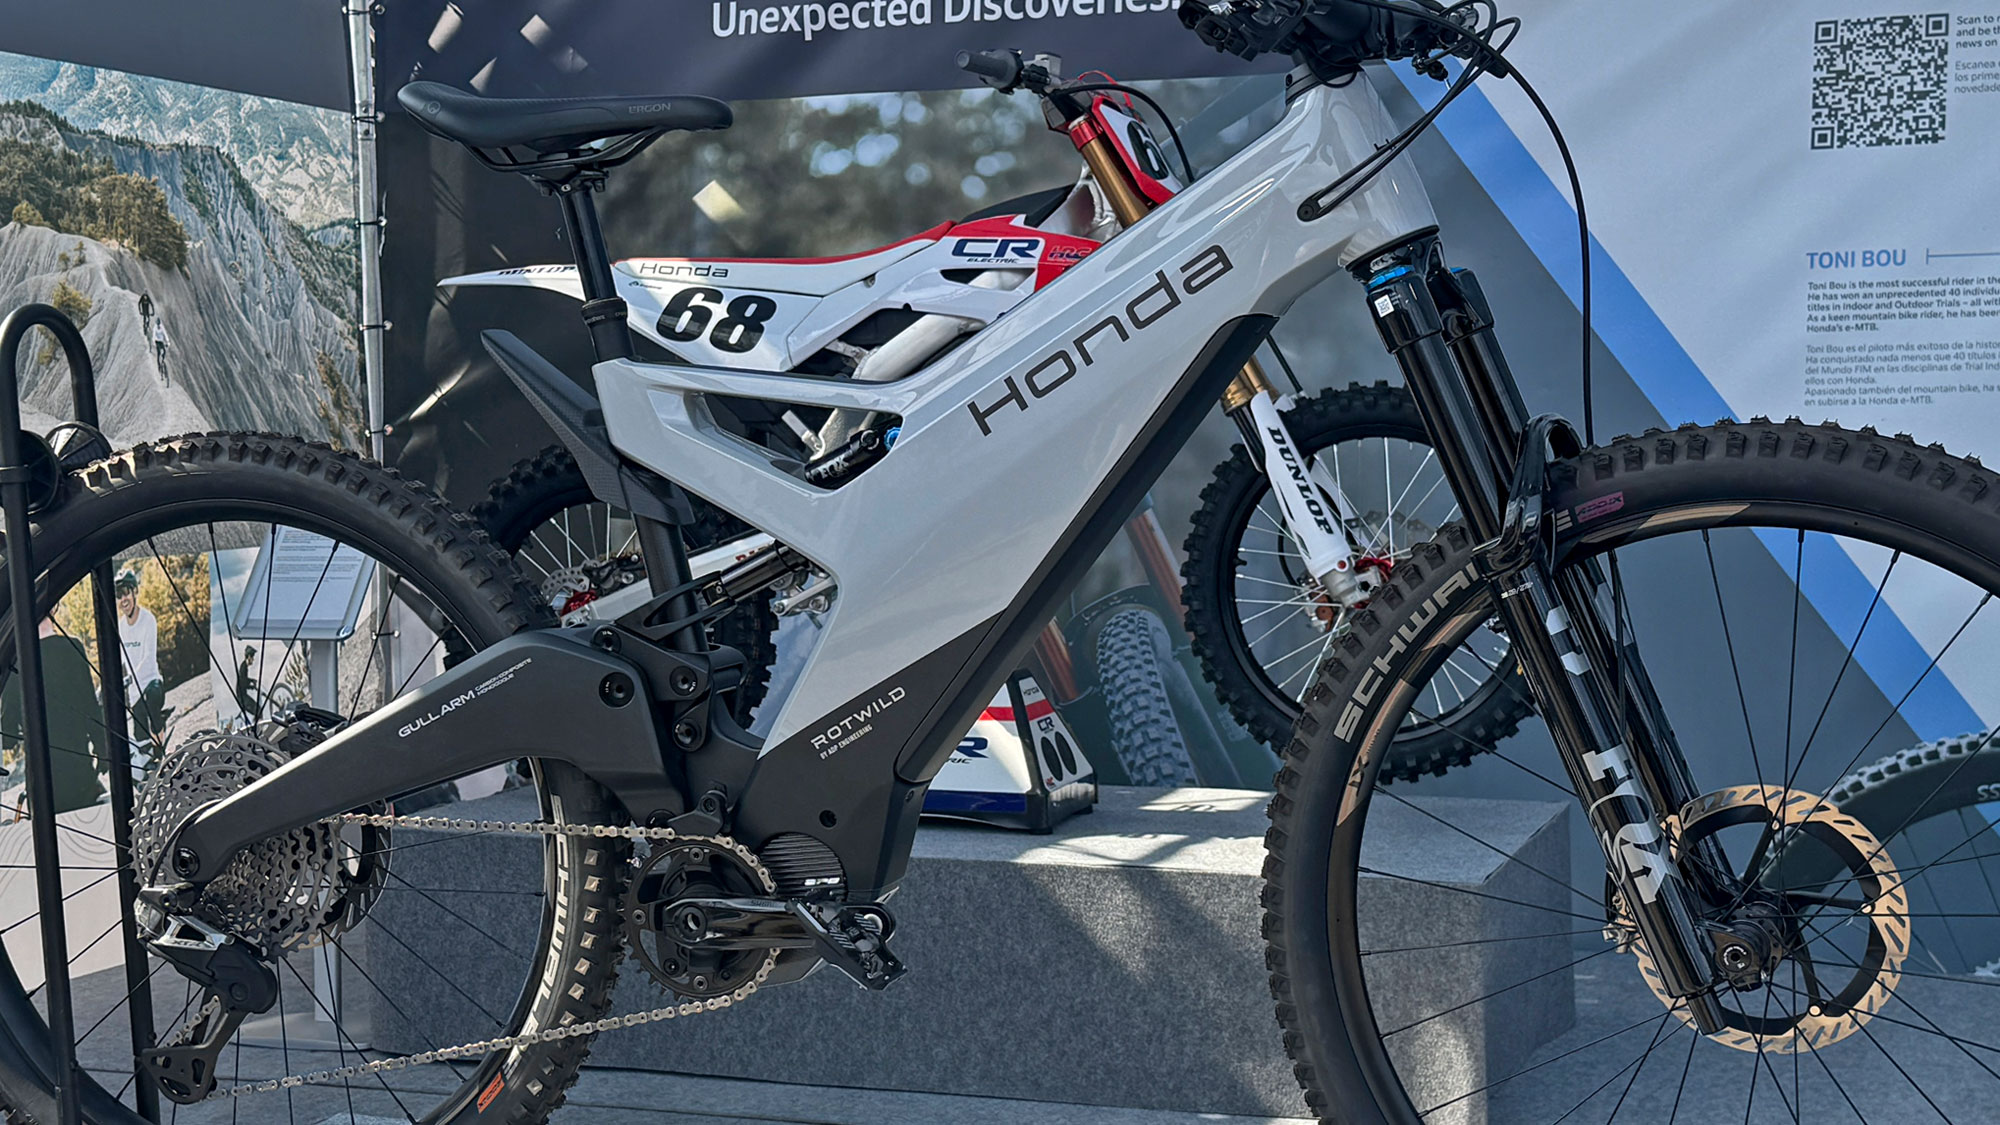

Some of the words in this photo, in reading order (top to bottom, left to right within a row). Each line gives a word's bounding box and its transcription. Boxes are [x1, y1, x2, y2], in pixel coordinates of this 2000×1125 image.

[712, 0, 932, 41] Unexpected
[1957, 15, 1980, 25] Scan
[1984, 14, 1994, 23] to
[1956, 27, 1975, 37] and
[1978, 27, 1991, 35] be
[1956, 40, 1982, 48] news
[1985, 39, 1998, 47] on
[1955, 61, 1995, 70] Escanea
[1954, 73, 1968, 81] los
[628, 102, 672, 114] ERGON
[1127, 120, 1169, 180] 6
[951, 238, 1041, 259] CR
[1806, 251, 1855, 269] TONI
[1861, 249, 1906, 267] BOU
[639, 262, 729, 278] Honda
[1808, 282, 1826, 290] Toni
[1829, 281, 1846, 289] Bou
[1849, 281, 1856, 289] is
[1859, 280, 1873, 288] the
[1876, 280, 1899, 288] most
[1902, 278, 1950, 287] successful
[1952, 277, 1974, 285] rider
[1808, 293, 1820, 301] He
[1823, 292, 1838, 300] has
[1876, 289, 1946, 300] unprecedented
[1949, 288, 1960, 296] 40
[1808, 303, 1830, 311] titles
[1843, 301, 1872, 310] Indoor
[1875, 301, 1892, 309] and
[1895, 300, 1934, 309] Outdoor
[1937, 299, 1960, 307] Trials
[1970, 298, 1981, 306] all
[1984, 298, 2000, 306] wit
[656, 287, 777, 353] 68
[1807, 314, 1818, 322] As
[1828, 313, 1849, 321] keen
[1852, 311, 1895, 321] mountain
[1899, 311, 1917, 319] bike
[1920, 310, 1943, 320] rider,
[1946, 310, 1957, 318] he
[1960, 309, 1976, 317] has
[1845, 323, 1878, 331] e-MTB.
[967, 244, 1234, 437] Honda
[1807, 345, 1824, 353] Toni
[1827, 344, 1843, 353] Bou
[1846, 345, 1855, 353] es
[1858, 343, 1866, 352] el
[1869, 343, 1893, 353] piloto
[1896, 342, 1915, 351] más
[1917, 342, 1949, 350] exitoso
[1952, 342, 1963, 350] de
[1966, 341, 1973, 349] la
[1806, 356, 1817, 364] Ha
[1820, 355, 1874, 365] conquistado
[1877, 354, 1899, 362] nada
[1901, 354, 1931, 362] menos
[1934, 353, 1950, 362] que
[1953, 353, 1965, 361] 40
[1968, 351, 1996, 360] títulos
[1805, 366, 1818, 375] del
[1821, 365, 1852, 374] Mundo
[1855, 365, 1871, 373] FIM
[1887, 364, 1899, 372] las
[1902, 363, 1948, 373] disciplinas
[1950, 363, 1961, 371] de
[1965, 362, 1982, 370] Trial
[1805, 377, 1825, 385] ellos
[1845, 376, 1876, 384] Honda.
[1805, 387, 1856, 396] Apasionado
[1859, 385, 1895, 394] también
[1898, 385, 1911, 393] del
[1914, 385, 1956, 393] mountain
[1959, 384, 1980, 393] bike,
[1983, 384, 1994, 392] ha
[1818, 397, 1849, 406] subirse
[1859, 397, 1866, 405] la
[1869, 396, 1898, 404] Honda
[1900, 395, 1933, 404] e-MTB.
[1267, 427, 1334, 535] DUNLOP
[810, 686, 906, 750] ROTWILD
[838, 724, 873, 749] ENGINEERING
